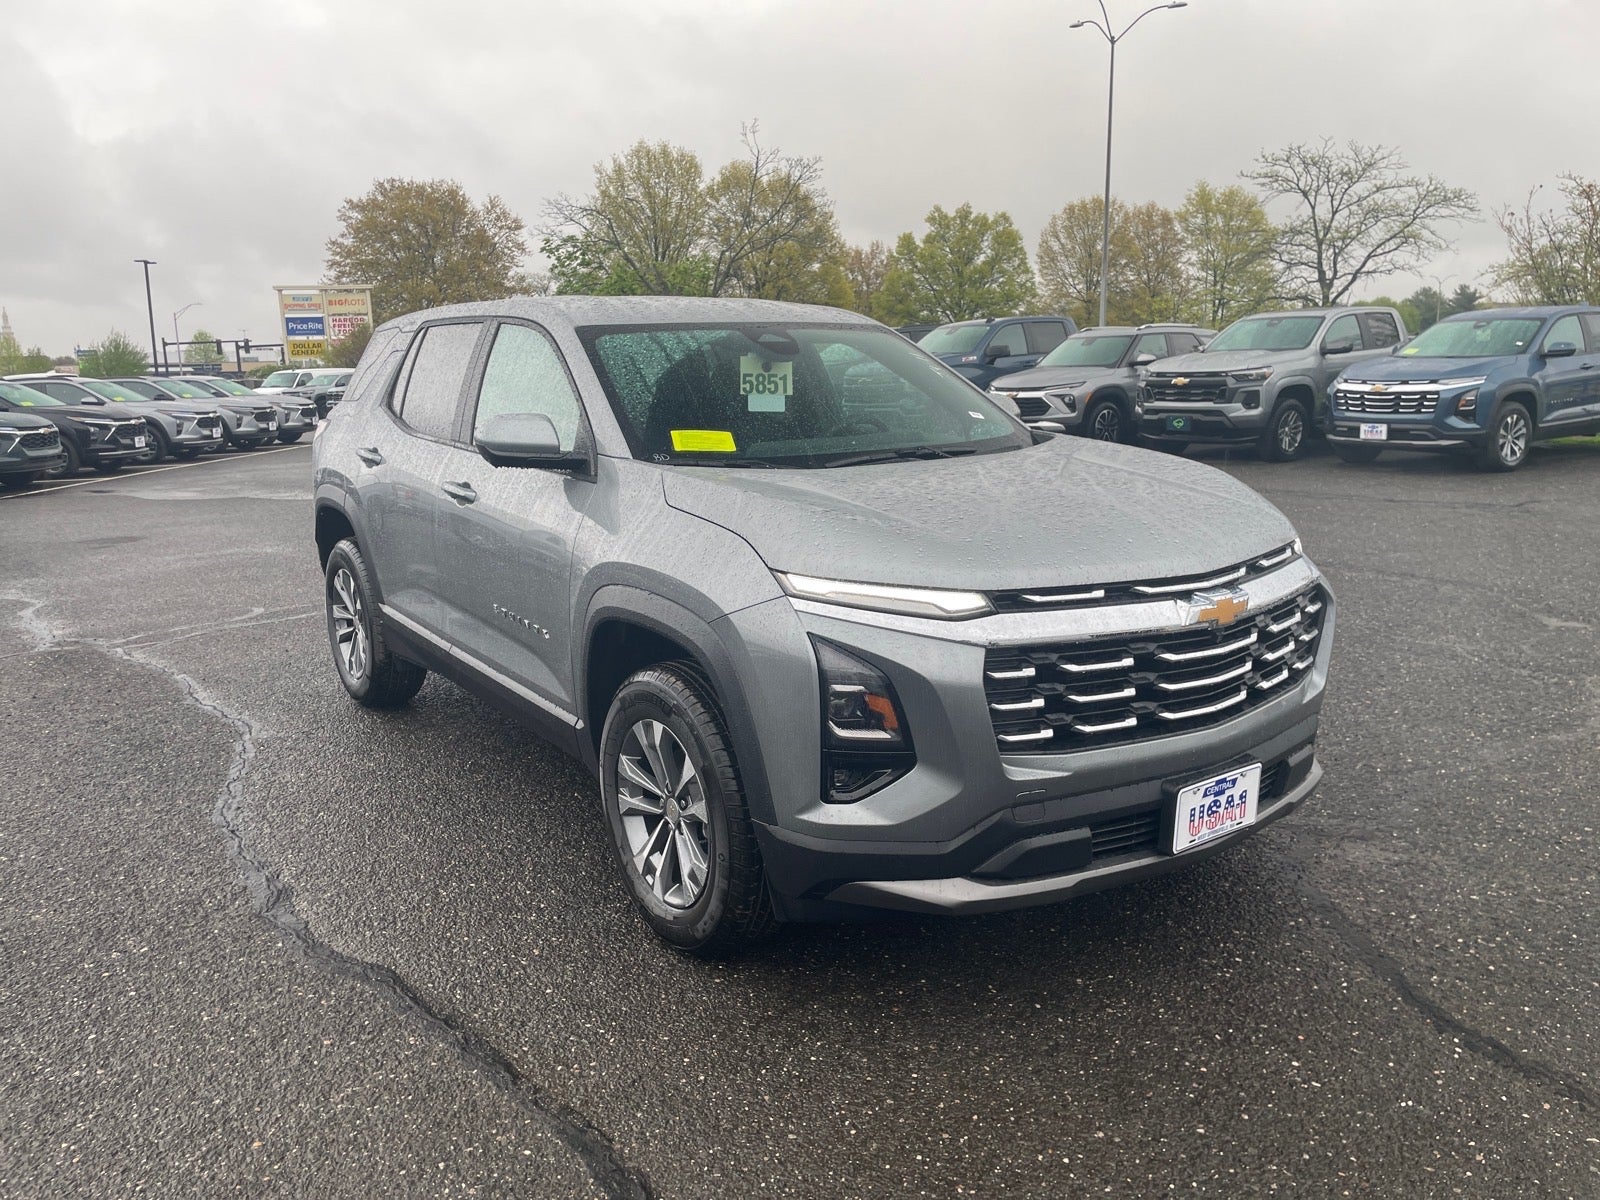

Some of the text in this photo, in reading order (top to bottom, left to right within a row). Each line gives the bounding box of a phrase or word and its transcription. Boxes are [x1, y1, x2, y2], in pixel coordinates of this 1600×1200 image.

[288, 322, 323, 330] Price Rite
[742, 373, 788, 395] 5851
[1206, 781, 1234, 795] CENTRAL
